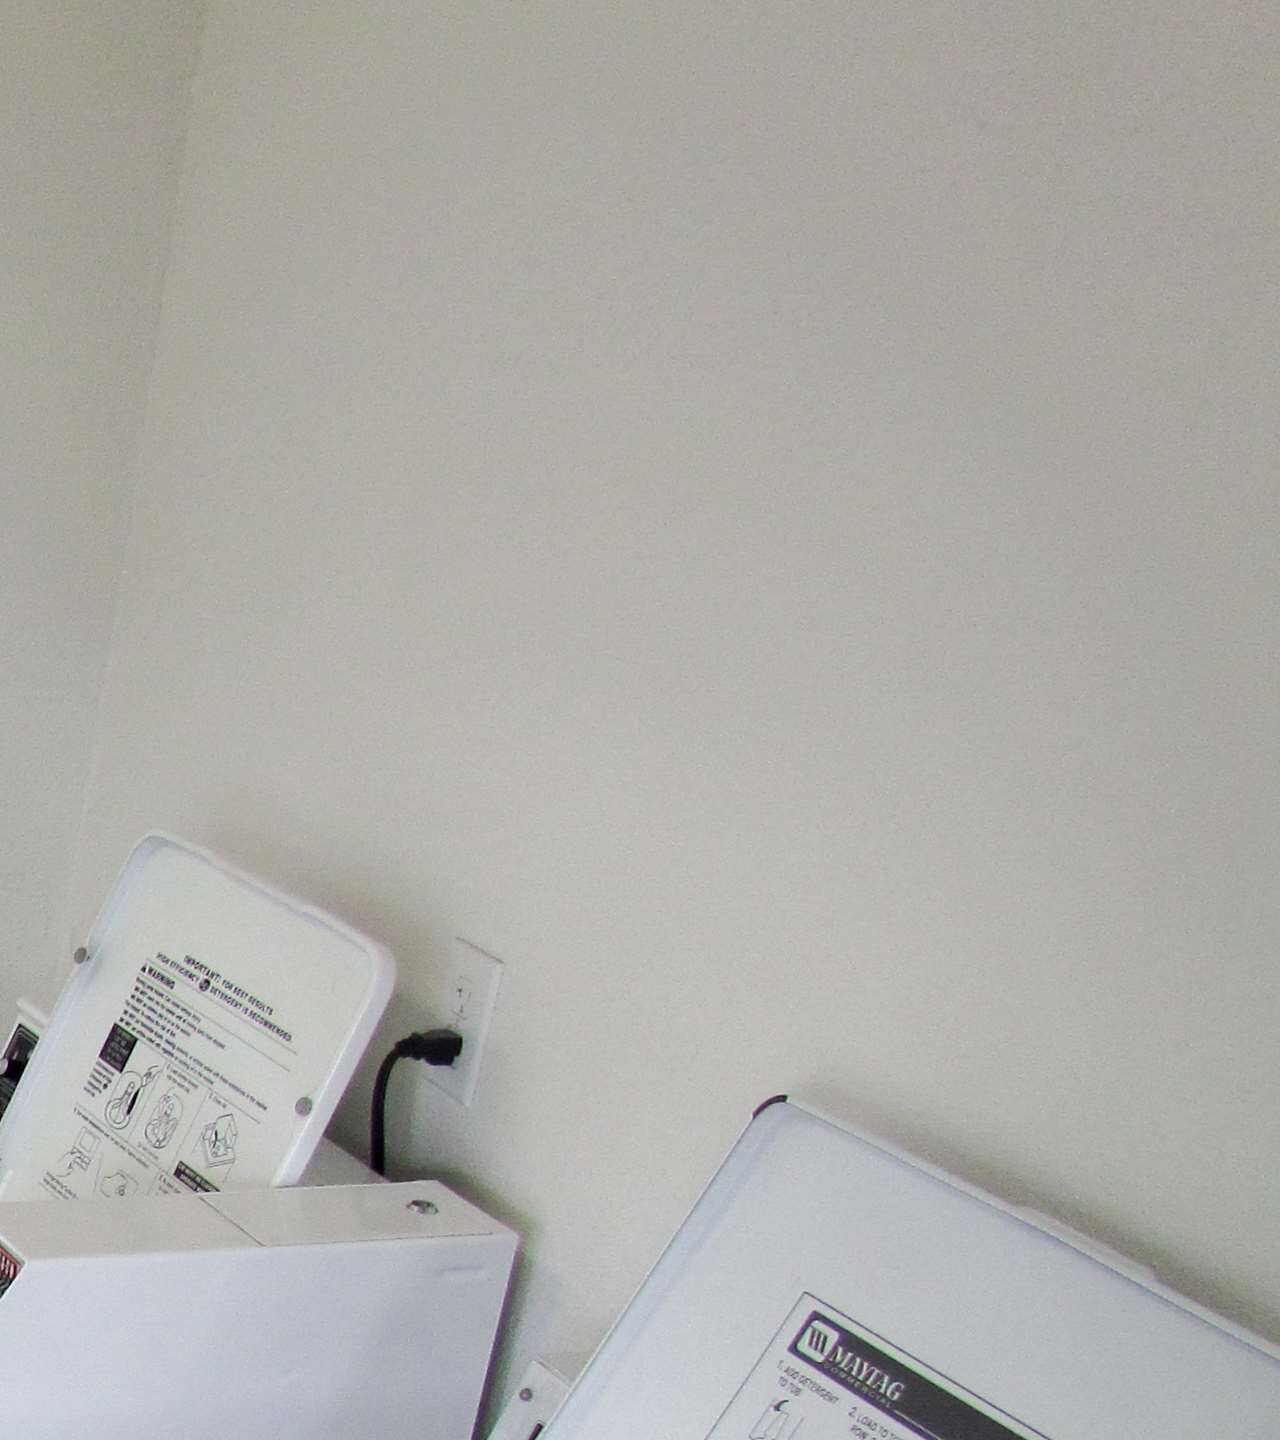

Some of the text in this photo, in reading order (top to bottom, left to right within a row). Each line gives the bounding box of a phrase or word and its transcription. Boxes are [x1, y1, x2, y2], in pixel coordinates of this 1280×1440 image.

[146, 966, 175, 989] WARNING
[776, 1376, 788, 1388] TO
[827, 1343, 906, 1402] MAYTAG
[849, 1424, 868, 1440] ROW
[856, 1412, 880, 1432] LOAD
[875, 1424, 890, 1439] TO
